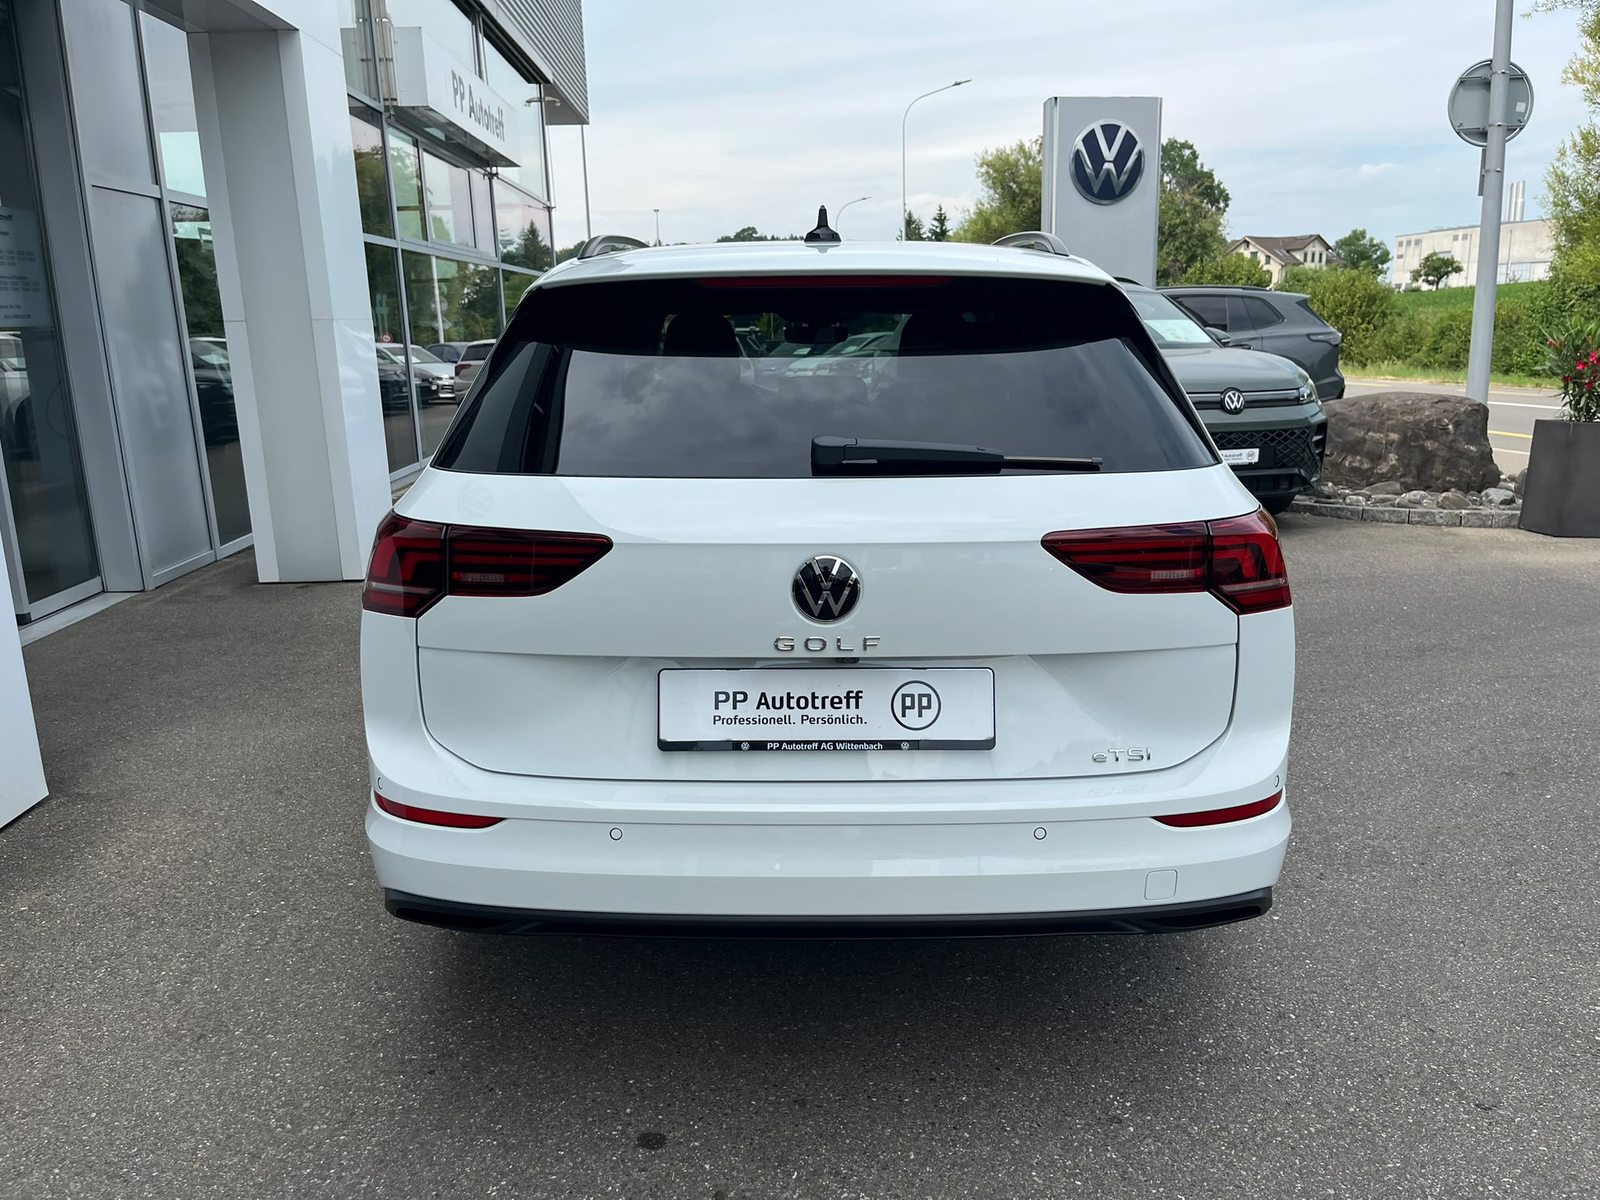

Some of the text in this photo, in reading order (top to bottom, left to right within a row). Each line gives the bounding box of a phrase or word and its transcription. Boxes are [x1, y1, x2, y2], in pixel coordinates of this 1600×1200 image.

[451, 69, 505, 143] PP Autotreff
[1071, 120, 1144, 201] VW
[1224, 390, 1245, 411] VW
[794, 557, 860, 620] VW
[774, 635, 881, 652] GOLF
[713, 690, 864, 710] PP Autotreff
[900, 693, 932, 718] PP
[712, 713, 868, 725] Professionell. Persönlich.
[767, 742, 883, 750] PP Autotreff AG Wittenbach
[1091, 747, 1151, 763] eTSI
